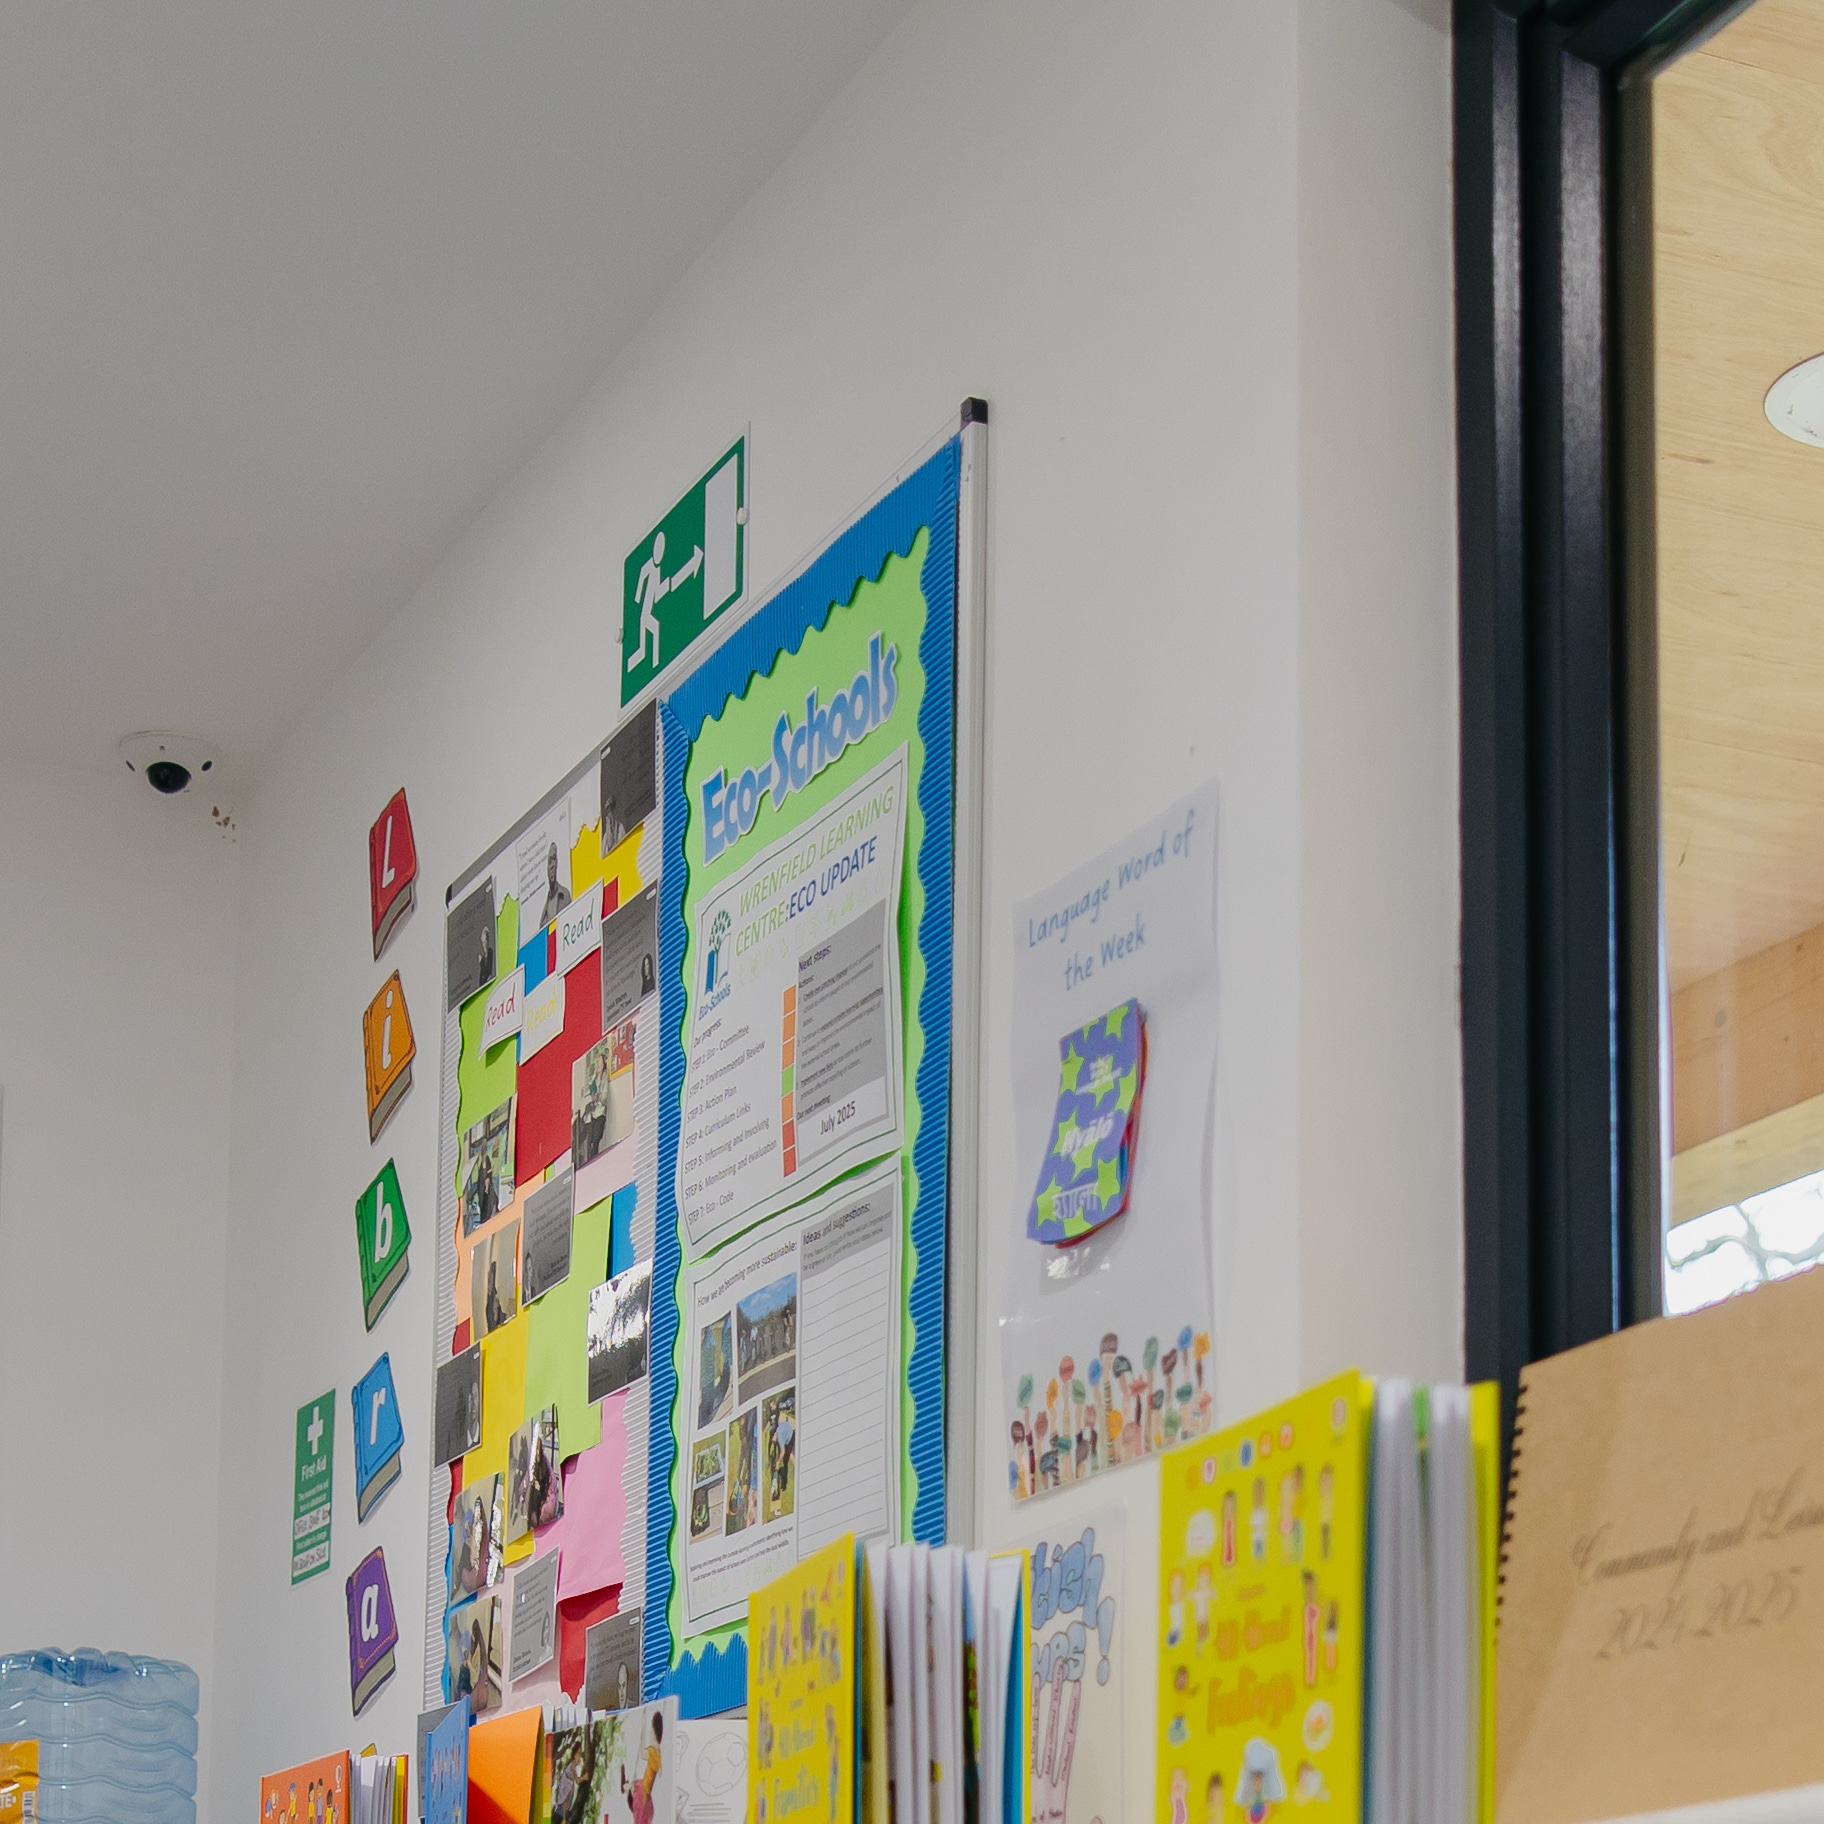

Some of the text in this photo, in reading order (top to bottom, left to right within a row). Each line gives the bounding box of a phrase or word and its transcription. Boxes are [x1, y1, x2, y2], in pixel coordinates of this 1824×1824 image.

[701, 630, 898, 867] Eco-Schools
[739, 785, 894, 917] WRENFIELD LEARNING
[819, 835, 878, 897] UPDATE
[1028, 808, 1195, 948] Language Word of
[561, 897, 595, 951] Read
[1064, 912, 1145, 991] the Week
[486, 982, 516, 1029] Read
[526, 984, 557, 1031] Read
[698, 983, 731, 1021] Eco-Schools
[719, 1025, 750, 1051] Committee
[689, 1085, 699, 1098] STEP
[705, 1051, 745, 1086] Environmental
[746, 1041, 766, 1061] Review
[685, 1135, 697, 1149] STEP
[704, 1109, 735, 1136] Curriculum
[736, 1102, 751, 1120] Links
[687, 1109, 697, 1123] STEP
[703, 1093, 723, 1113] Action
[724, 1085, 737, 1102] Plan
[820, 1099, 857, 1137] July 2025
[684, 1159, 697, 1175] STEP
[704, 1136, 732, 1163] Informing
[733, 1131, 744, 1144] and
[744, 1117, 769, 1142] Involving
[684, 1185, 697, 1200] STEP
[704, 1163, 736, 1188] Monitoring
[737, 1157, 748, 1174] and
[748, 1140, 777, 1168] evaluation
[687, 1209, 699, 1226] STEP
[706, 1200, 716, 1213] Eco
[719, 1190, 734, 1207] Code
[802, 1202, 871, 1246] Ideas and suggestions:
[746, 1261, 760, 1276] more
[761, 1241, 798, 1266] sustainable:
[301, 1454, 327, 1482] First Aid
